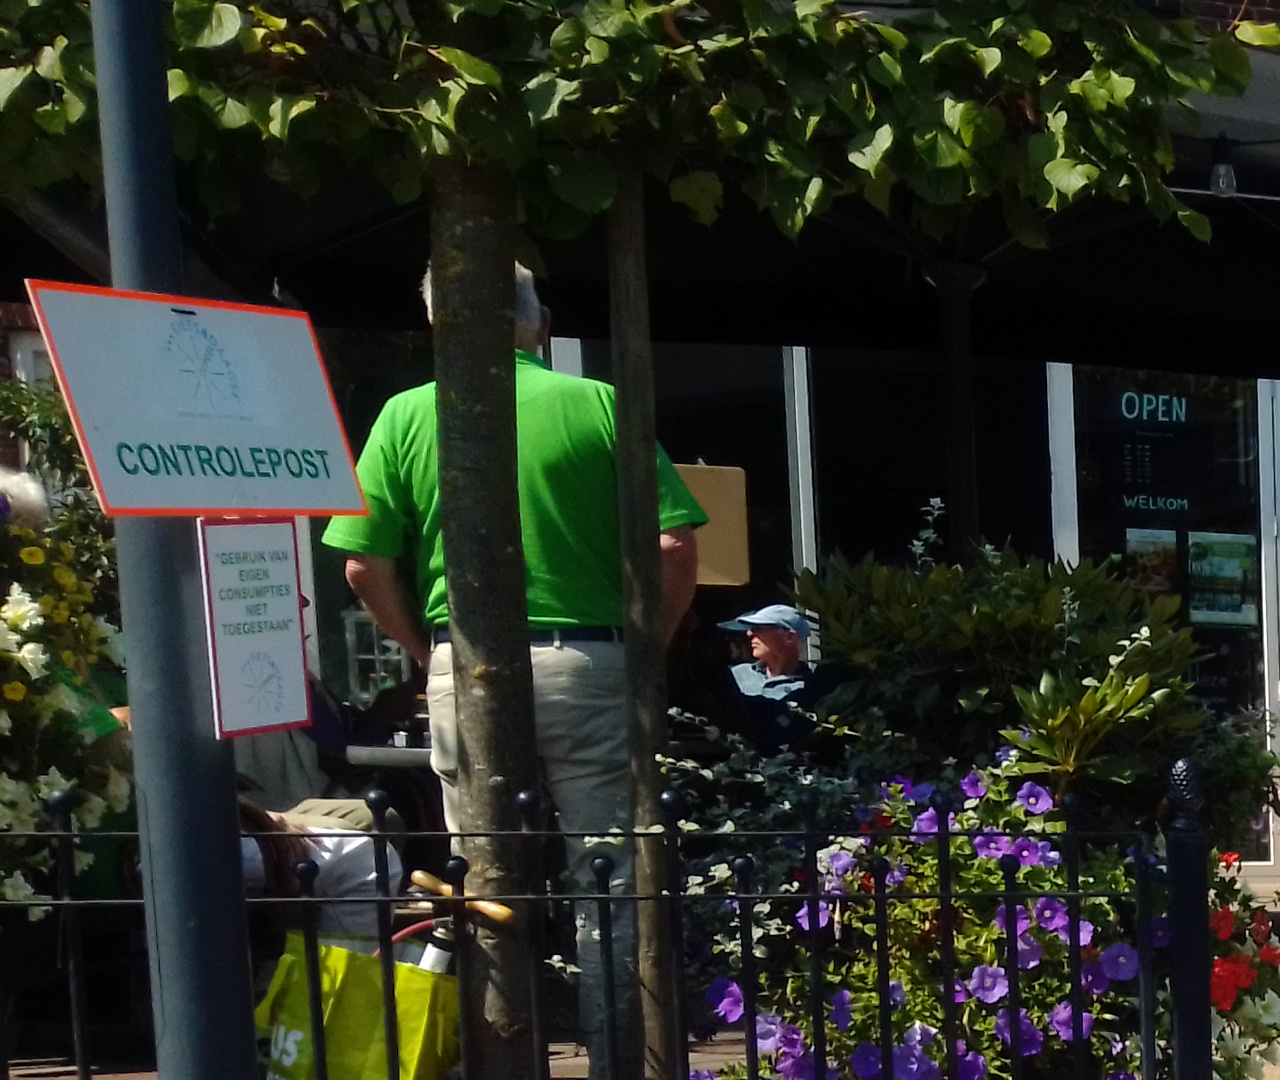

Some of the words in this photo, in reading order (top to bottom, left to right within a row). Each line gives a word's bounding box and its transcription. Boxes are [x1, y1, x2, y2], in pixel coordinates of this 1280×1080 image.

[1121, 391, 1188, 423] OPEN
[116, 441, 333, 480] CONTROLEPOST
[1123, 494, 1189, 512] WELKOM
[268, 550, 289, 562] VAN
[238, 568, 270, 582] EIGEN
[219, 584, 292, 601] CONSUMPTIES
[246, 603, 269, 617] NIET
